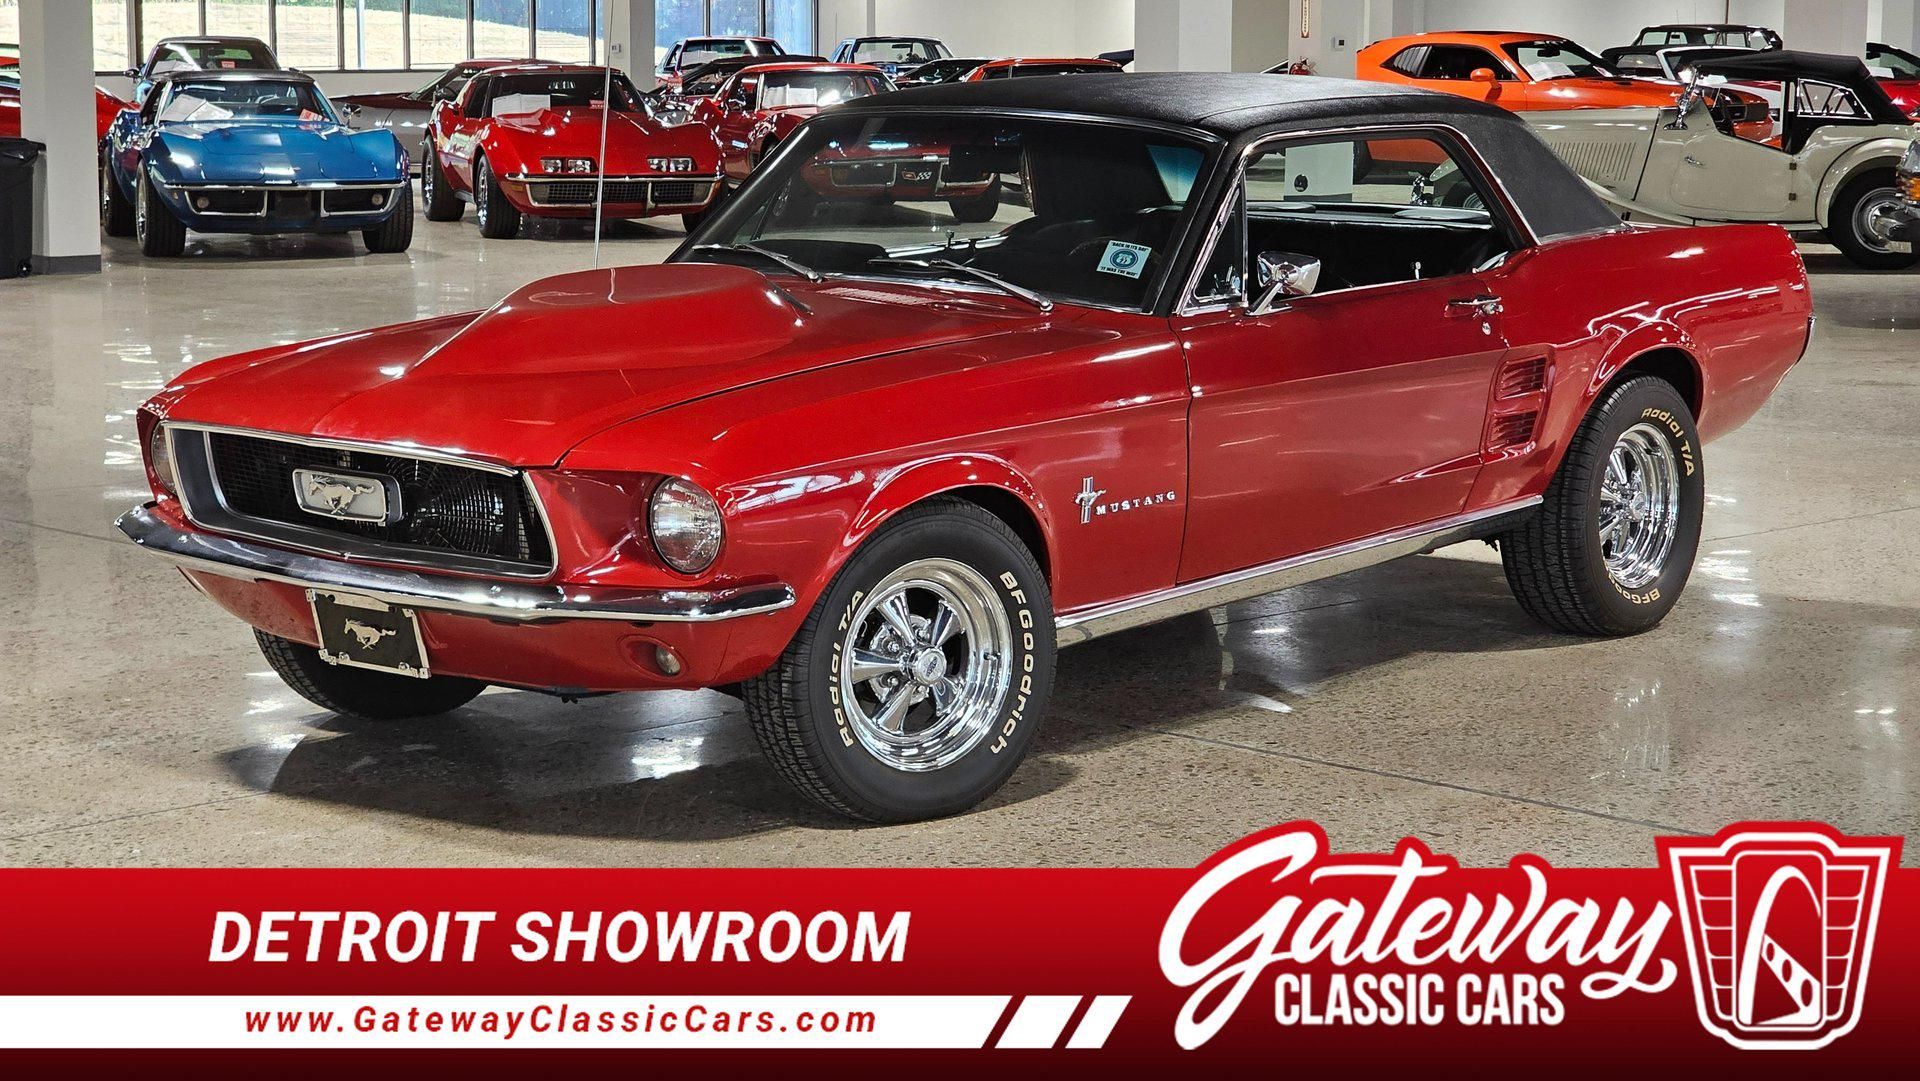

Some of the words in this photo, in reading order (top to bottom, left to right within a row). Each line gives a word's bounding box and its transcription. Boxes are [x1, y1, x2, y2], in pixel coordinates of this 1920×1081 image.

[1641, 407, 1684, 438] Radial
[1680, 437, 1695, 477] T/A
[1095, 491, 1176, 515] MUSTANG
[838, 589, 864, 632] T/A
[827, 642, 854, 748] Radial
[990, 570, 1034, 755] BFGoodrich
